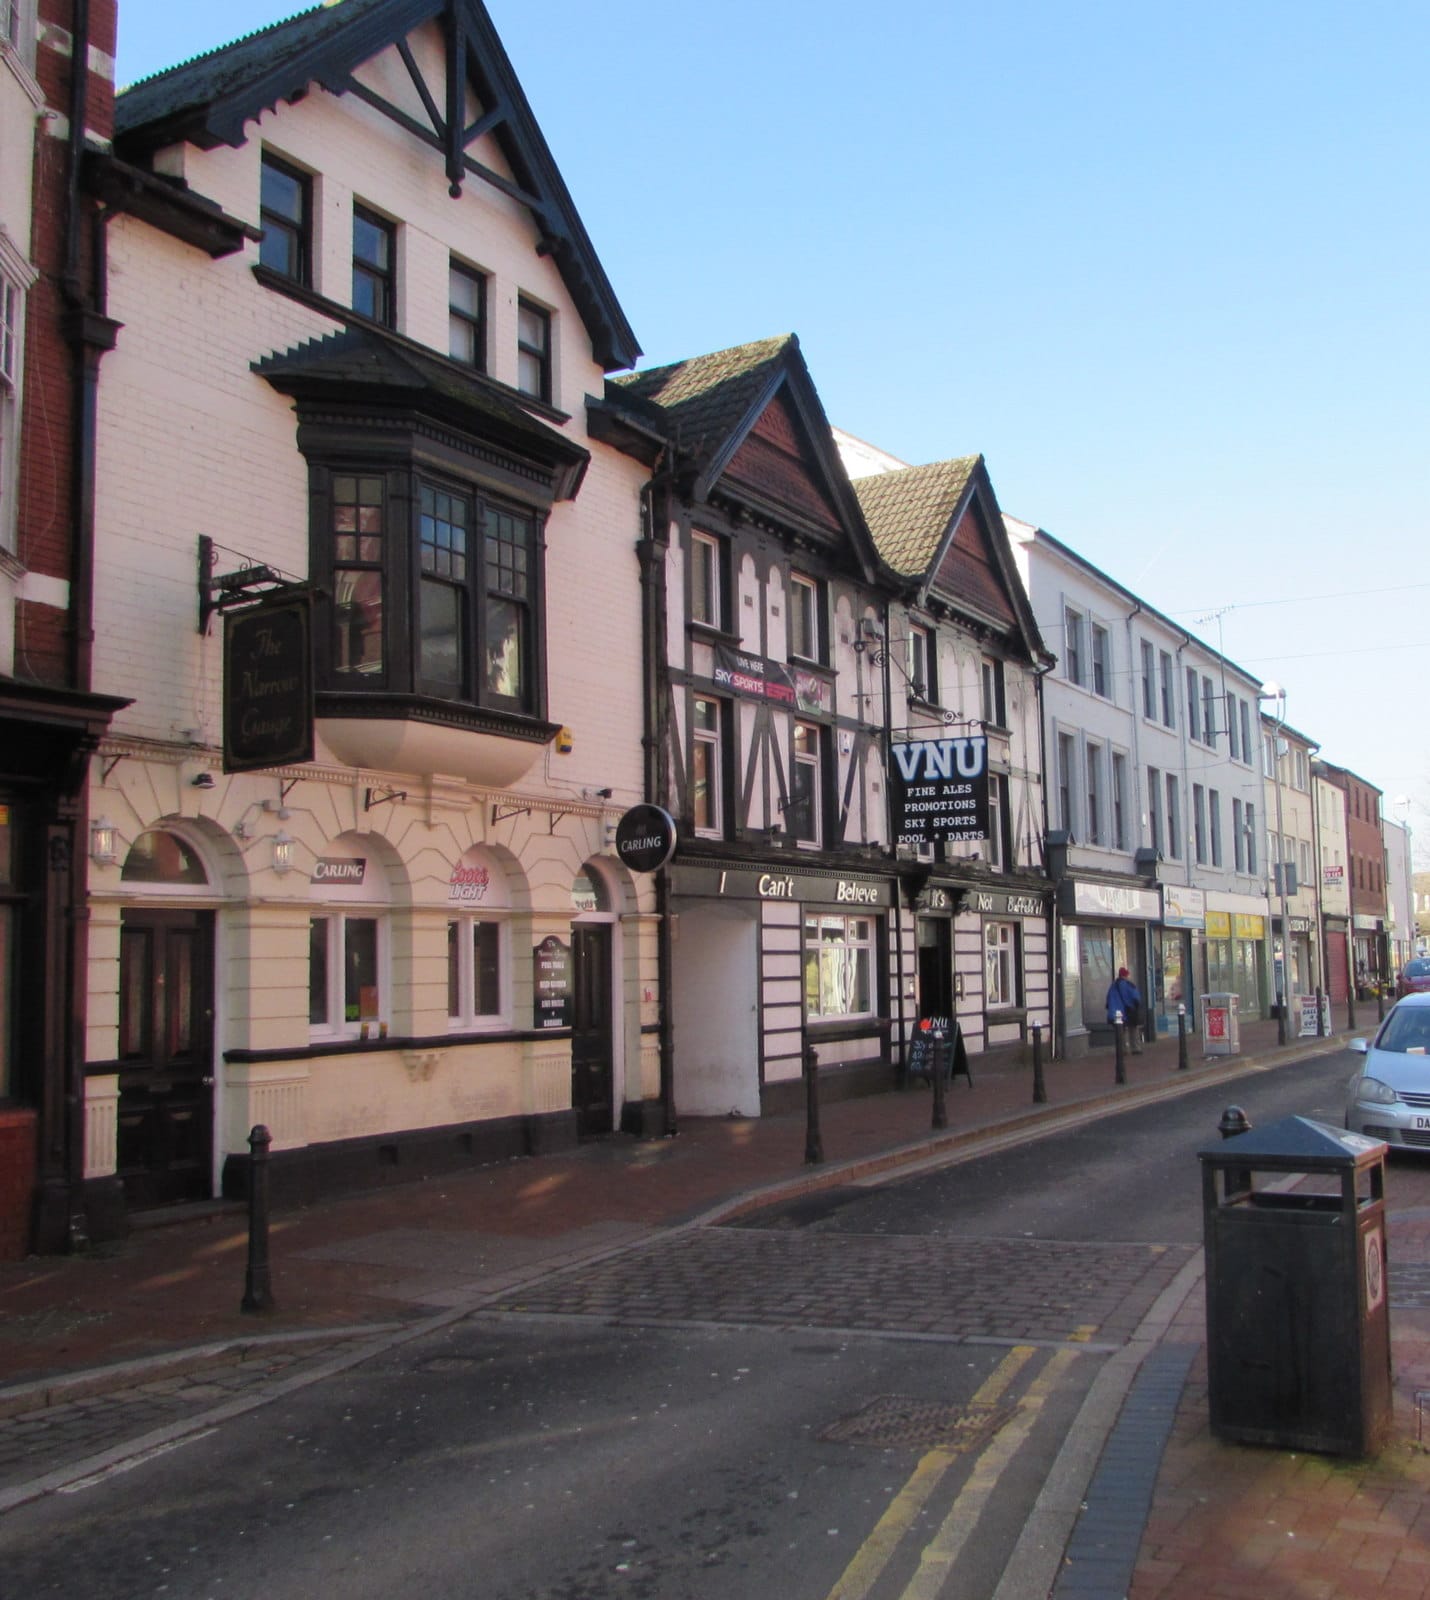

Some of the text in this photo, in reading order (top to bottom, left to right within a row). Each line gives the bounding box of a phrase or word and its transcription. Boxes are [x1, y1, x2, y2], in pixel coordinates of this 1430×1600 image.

[715, 669, 732, 683] SKY
[733, 675, 764, 693] SPORTS
[892, 738, 985, 781] VNU
[907, 784, 972, 797] FINE ALES
[904, 800, 976, 812] PROMOTIONS
[904, 816, 976, 828] SKY SPORTS
[621, 836, 661, 852] CARLING
[898, 831, 984, 843] POOL DARTS
[313, 862, 363, 879] CARLING
[450, 859, 489, 886] Coors
[448, 884, 487, 900] LIGHT
[719, 872, 726, 893] I
[758, 874, 794, 897] Can't
[837, 881, 878, 902] Believe
[977, 893, 992, 911] Not
